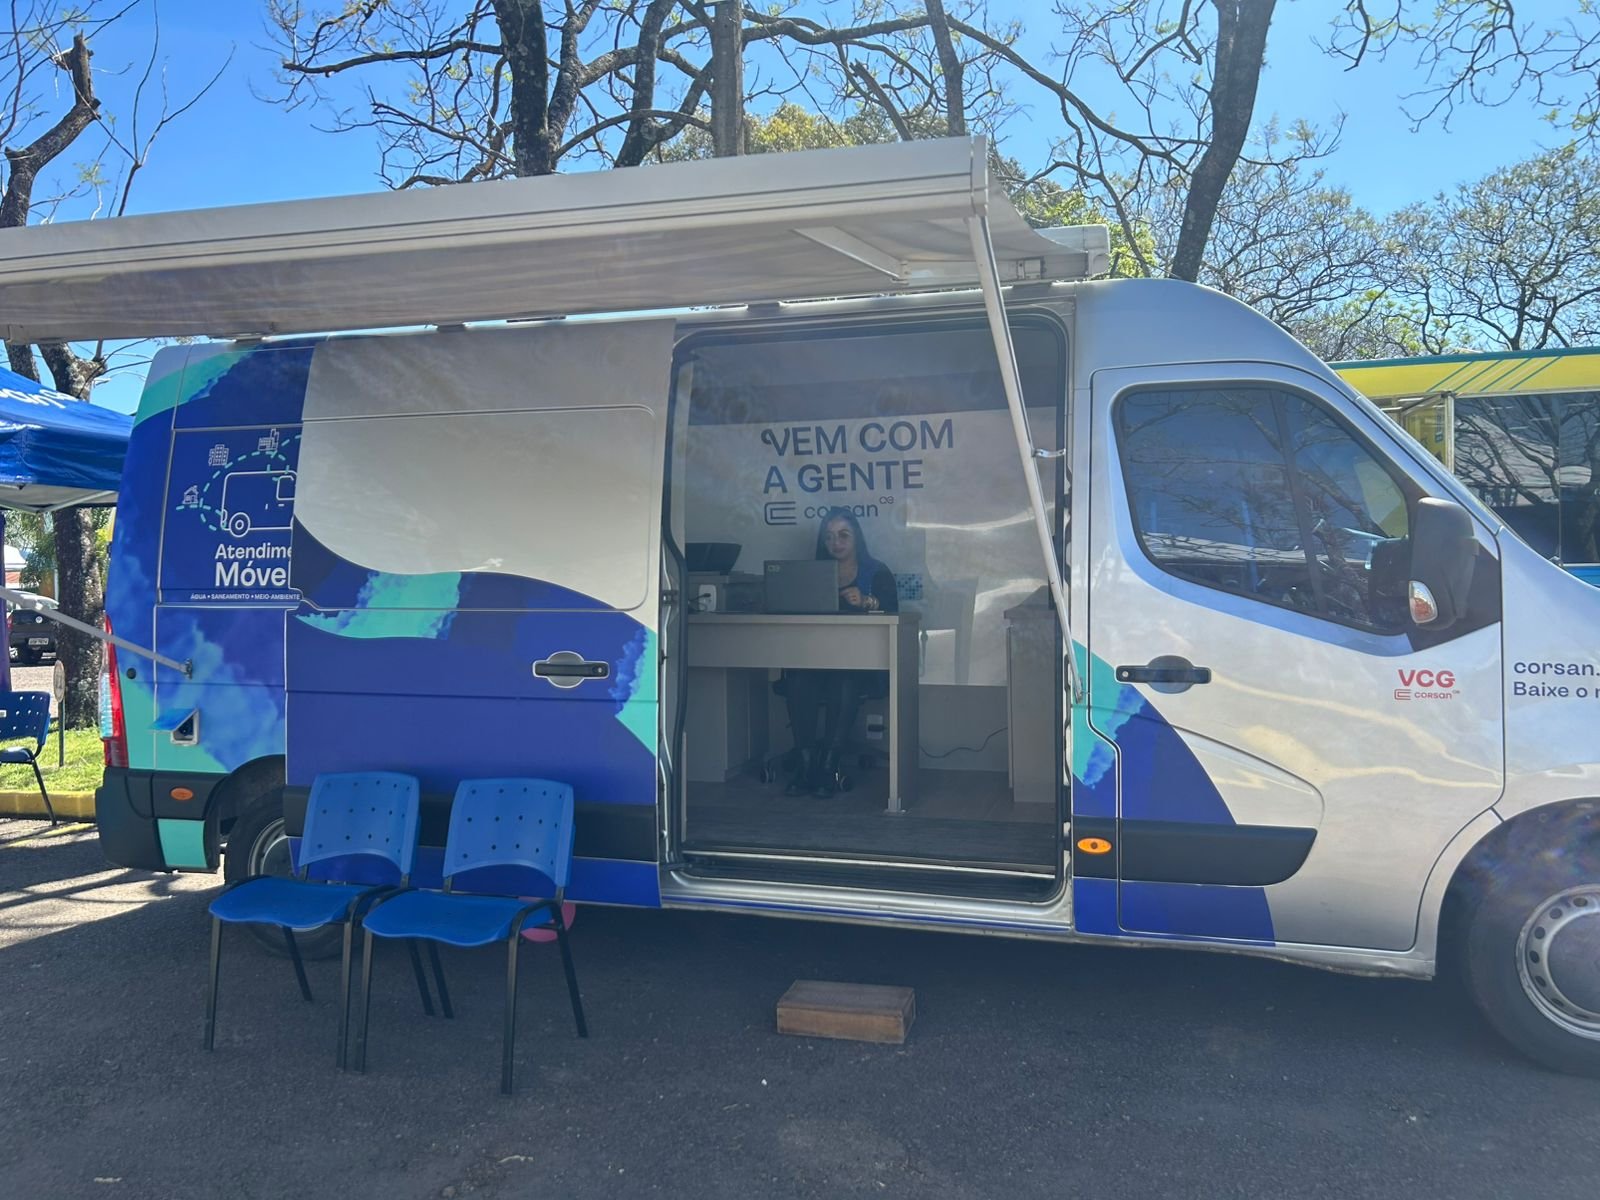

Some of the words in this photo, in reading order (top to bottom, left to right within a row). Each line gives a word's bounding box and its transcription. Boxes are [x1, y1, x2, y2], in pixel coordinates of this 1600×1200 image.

[760, 424, 848, 457] VEM
[859, 418, 954, 453] COM
[762, 465, 788, 494] A
[797, 459, 924, 493] GENTE
[803, 504, 879, 519] coan
[190, 592, 207, 600] ÁGUA
[1513, 661, 1600, 677] corsan.
[1397, 669, 1456, 688] VCG
[1513, 681, 1570, 698] Baixe
[1575, 687, 1588, 698] o
